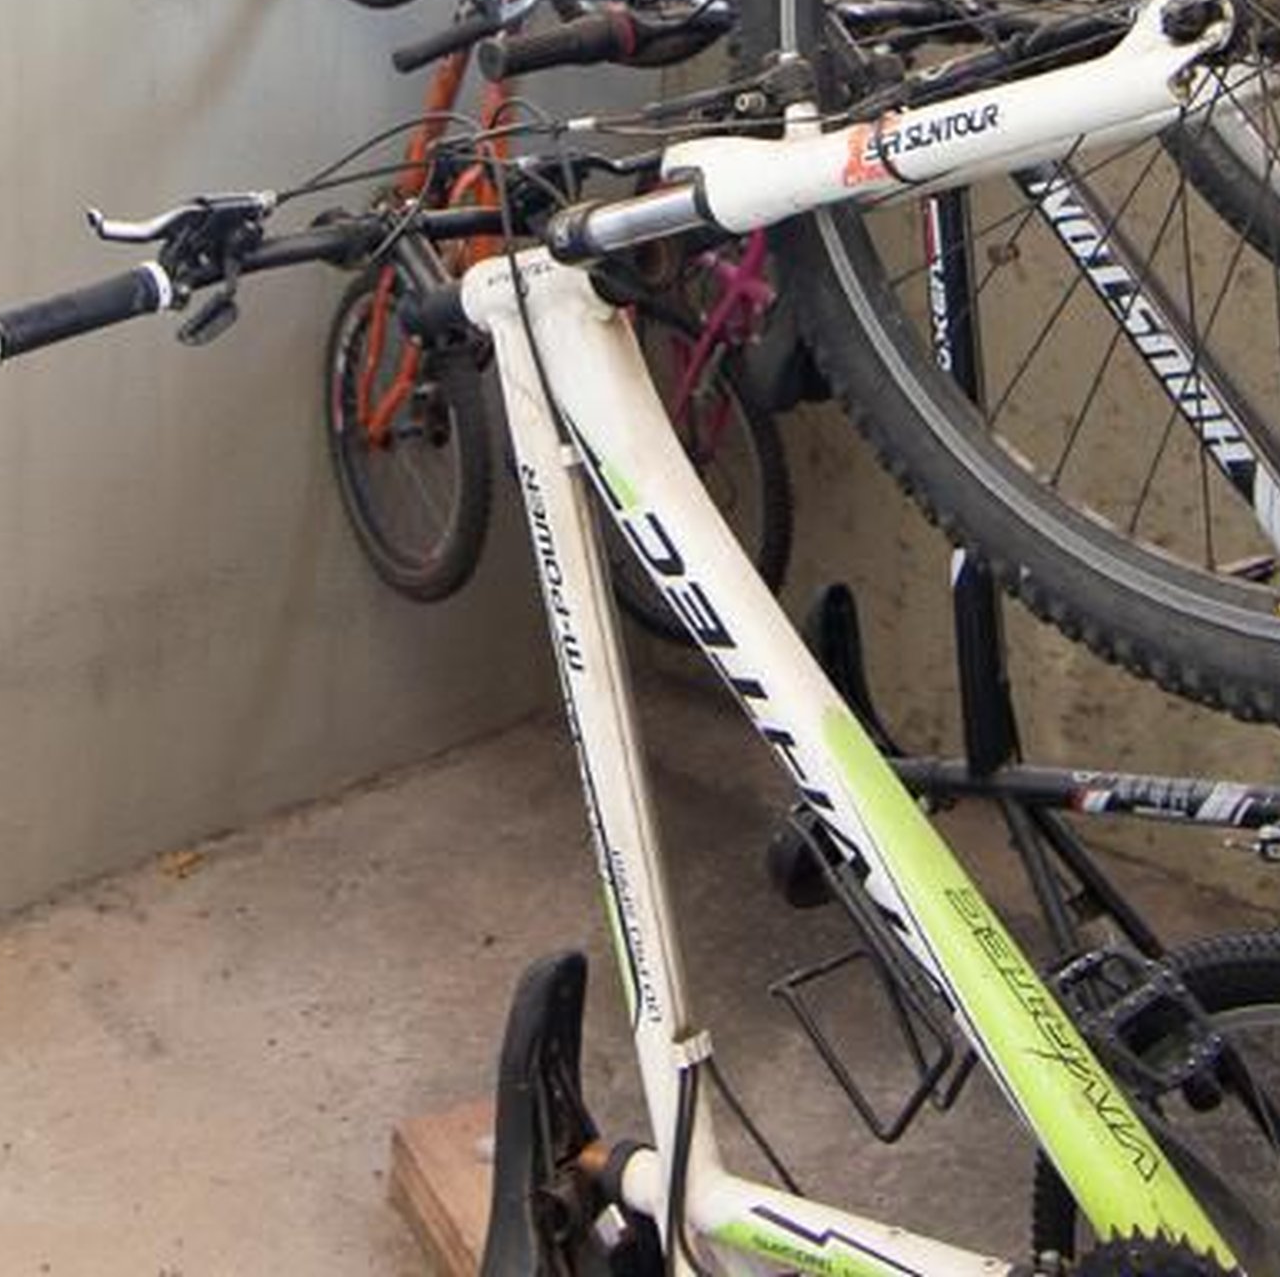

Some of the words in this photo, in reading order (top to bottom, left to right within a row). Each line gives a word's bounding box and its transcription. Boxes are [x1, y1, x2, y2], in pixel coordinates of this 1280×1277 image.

[904, 103, 1000, 151] SUNTOUR
[1028, 176, 1255, 472] HOUSTON
[520, 464, 585, 673] M-POWER
